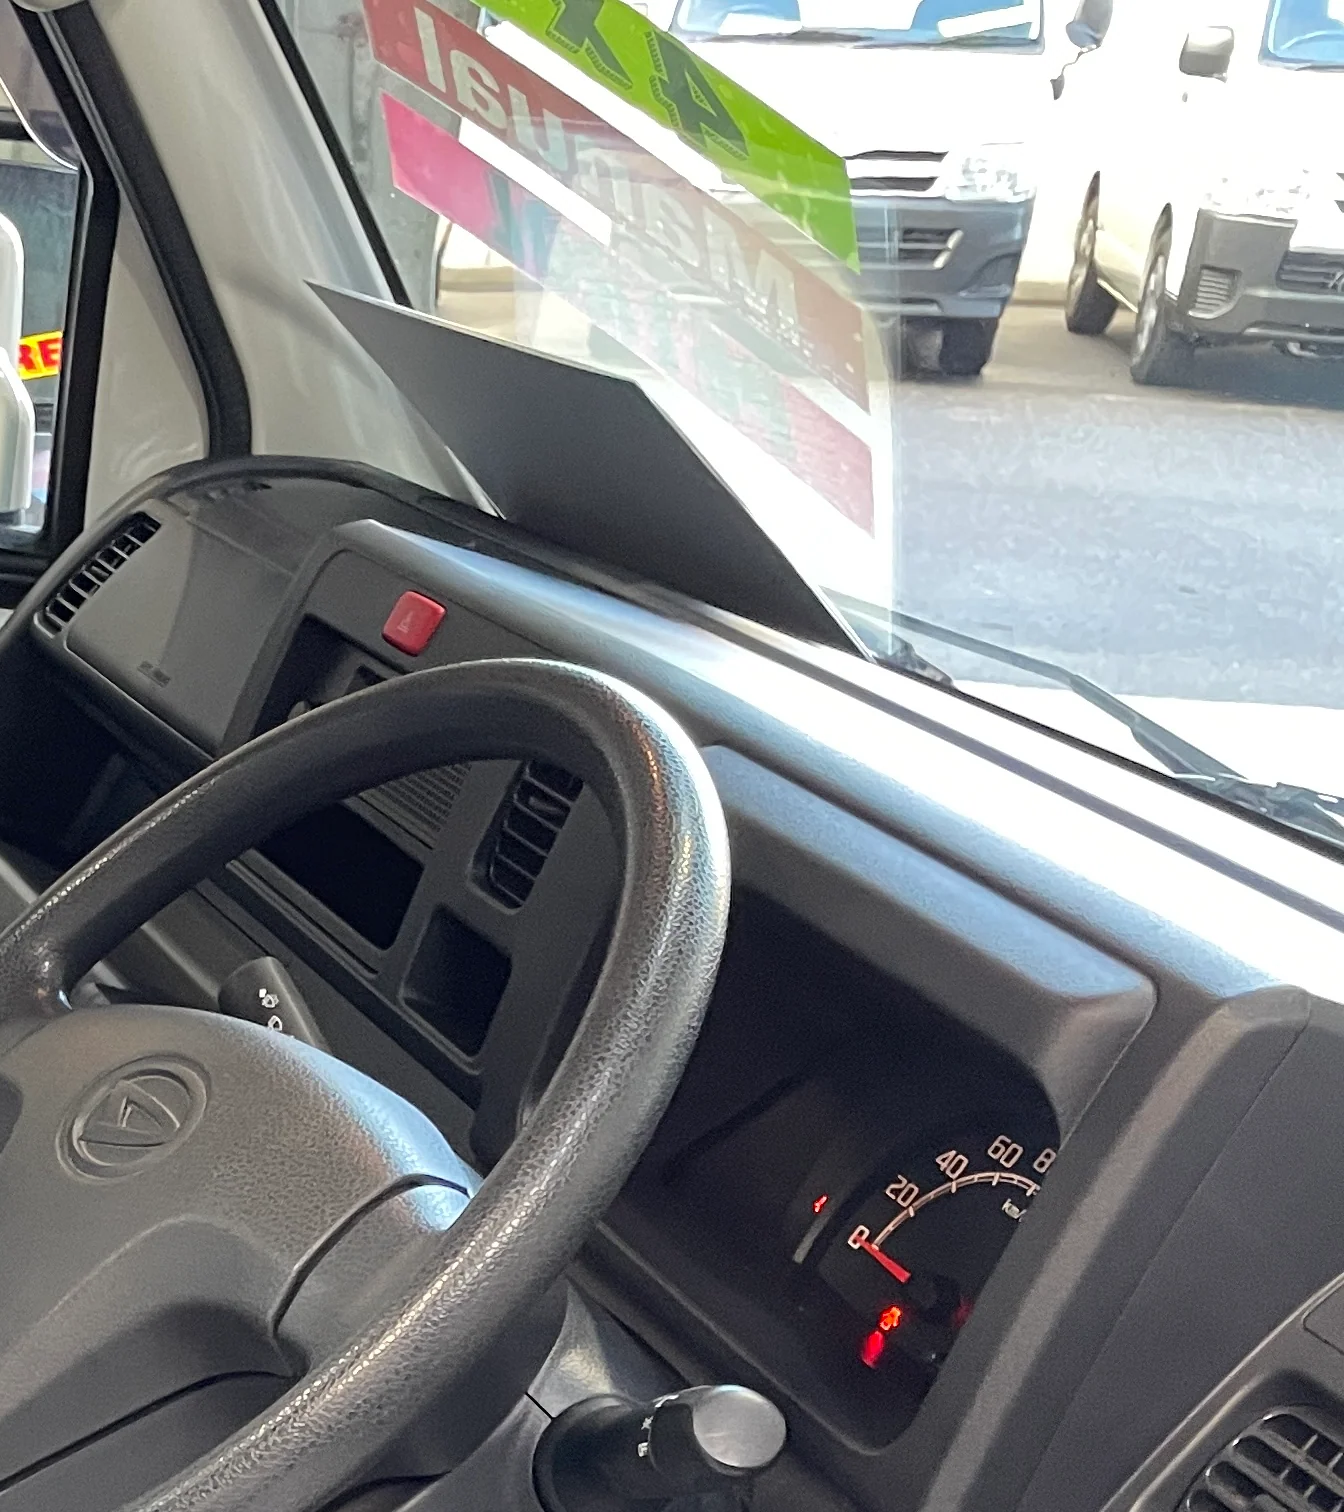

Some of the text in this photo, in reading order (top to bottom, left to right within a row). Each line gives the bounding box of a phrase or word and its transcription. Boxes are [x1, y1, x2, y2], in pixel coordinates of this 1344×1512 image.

[935, 1149, 969, 1180] 40
[987, 1134, 1024, 1169] 60
[1033, 1148, 1056, 1173] 8
[885, 1173, 920, 1208] 20
[847, 1224, 870, 1249] 0
